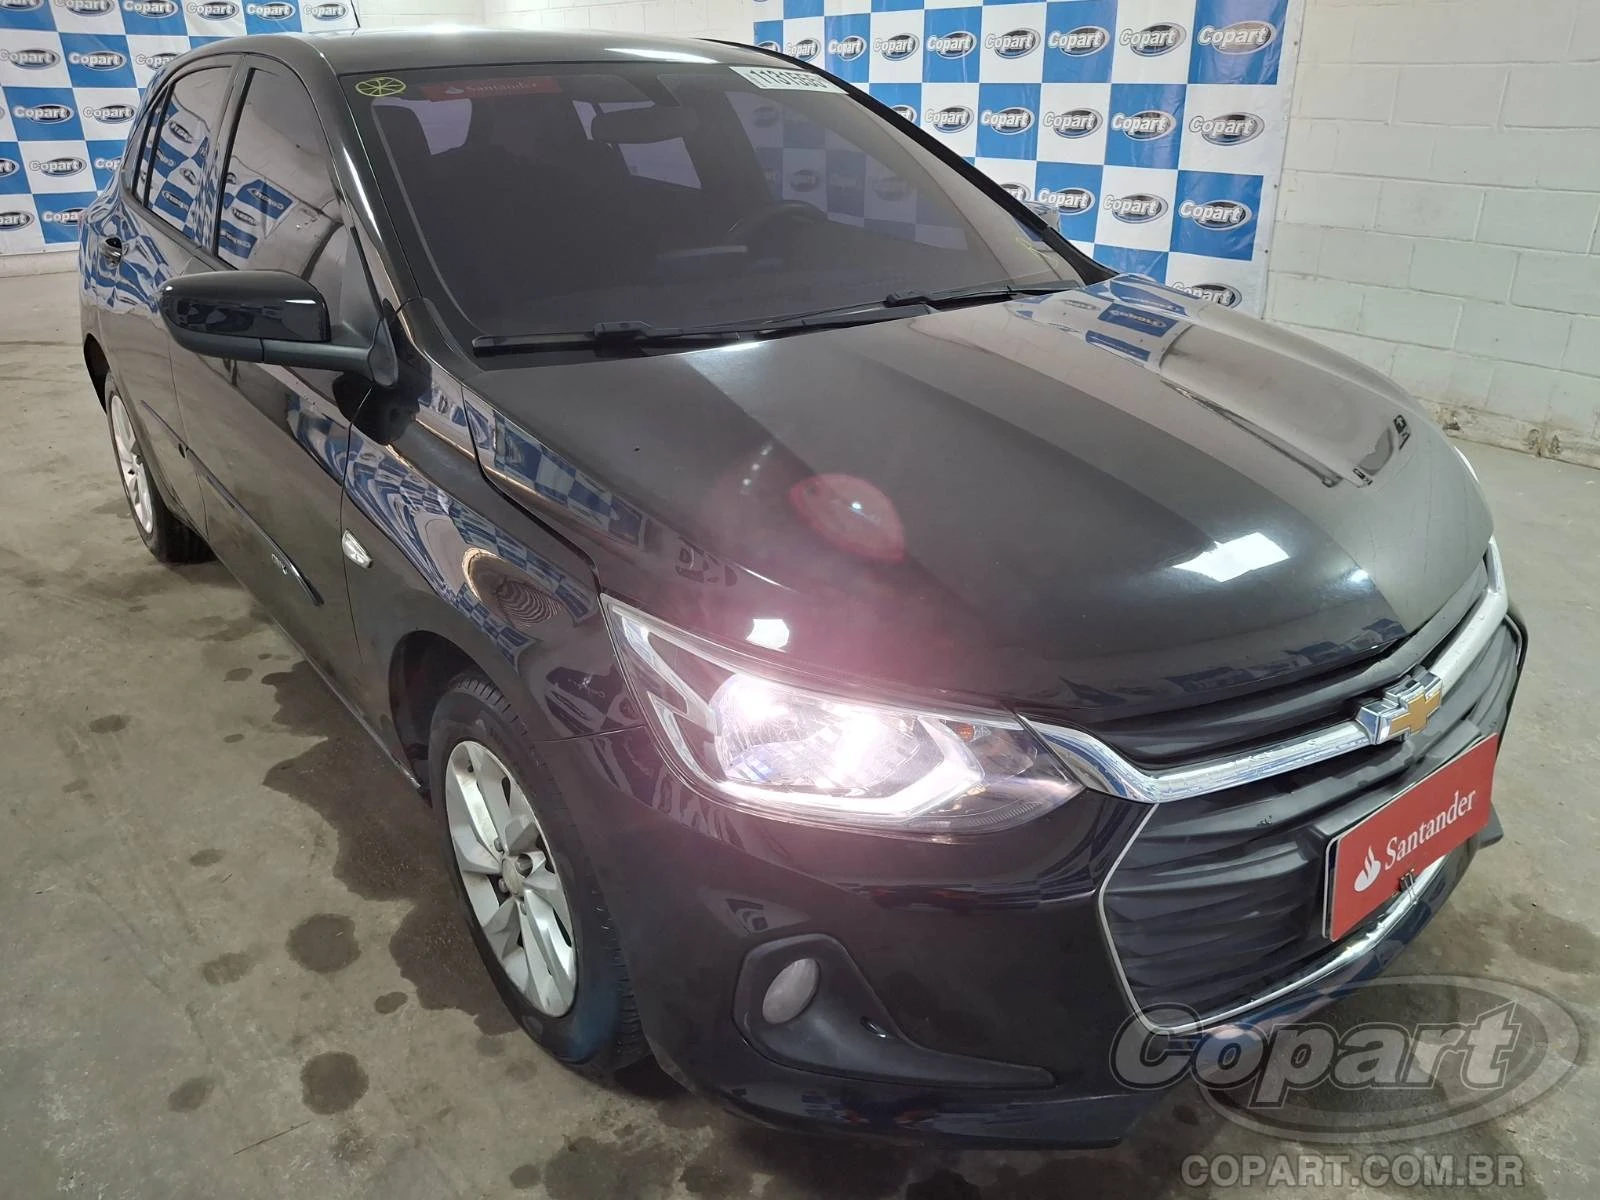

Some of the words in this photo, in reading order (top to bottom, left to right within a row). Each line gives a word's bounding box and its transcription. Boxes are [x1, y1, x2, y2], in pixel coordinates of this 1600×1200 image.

[122, 0, 172, 15] Copart
[187, 2, 233, 16] Copart
[246, 4, 290, 17] Copart
[303, 5, 344, 18] Copart
[927, 34, 974, 53] Copart
[984, 31, 1035, 52] Copart
[1048, 30, 1101, 49] Copart
[1119, 27, 1177, 48] Copart
[1198, 25, 1268, 47] Copart
[784, 41, 817, 58] Copart
[828, 39, 862, 56] Copart
[873, 37, 914, 55] Copart
[0, 49, 51, 65] Copart
[68, 52, 121, 67] Copart
[136, 54, 174, 68] Copa
[14, 105, 67, 119] Copart
[83, 106, 132, 120] Copart
[925, 108, 968, 126] Copart
[981, 110, 1029, 128] Copart
[1043, 112, 1098, 130] Copart
[1111, 114, 1168, 134] Copart
[1189, 116, 1252, 136] Copart
[29, 160, 80, 172] Copart
[95, 158, 121, 171] Cop
[1038, 188, 1088, 209] Copart
[1103, 194, 1157, 215] Copart
[0, 211, 28, 226] part
[43, 210, 80, 223] Copa
[1179, 199, 1242, 223] Copart
[1384, 788, 1477, 870] Santander
